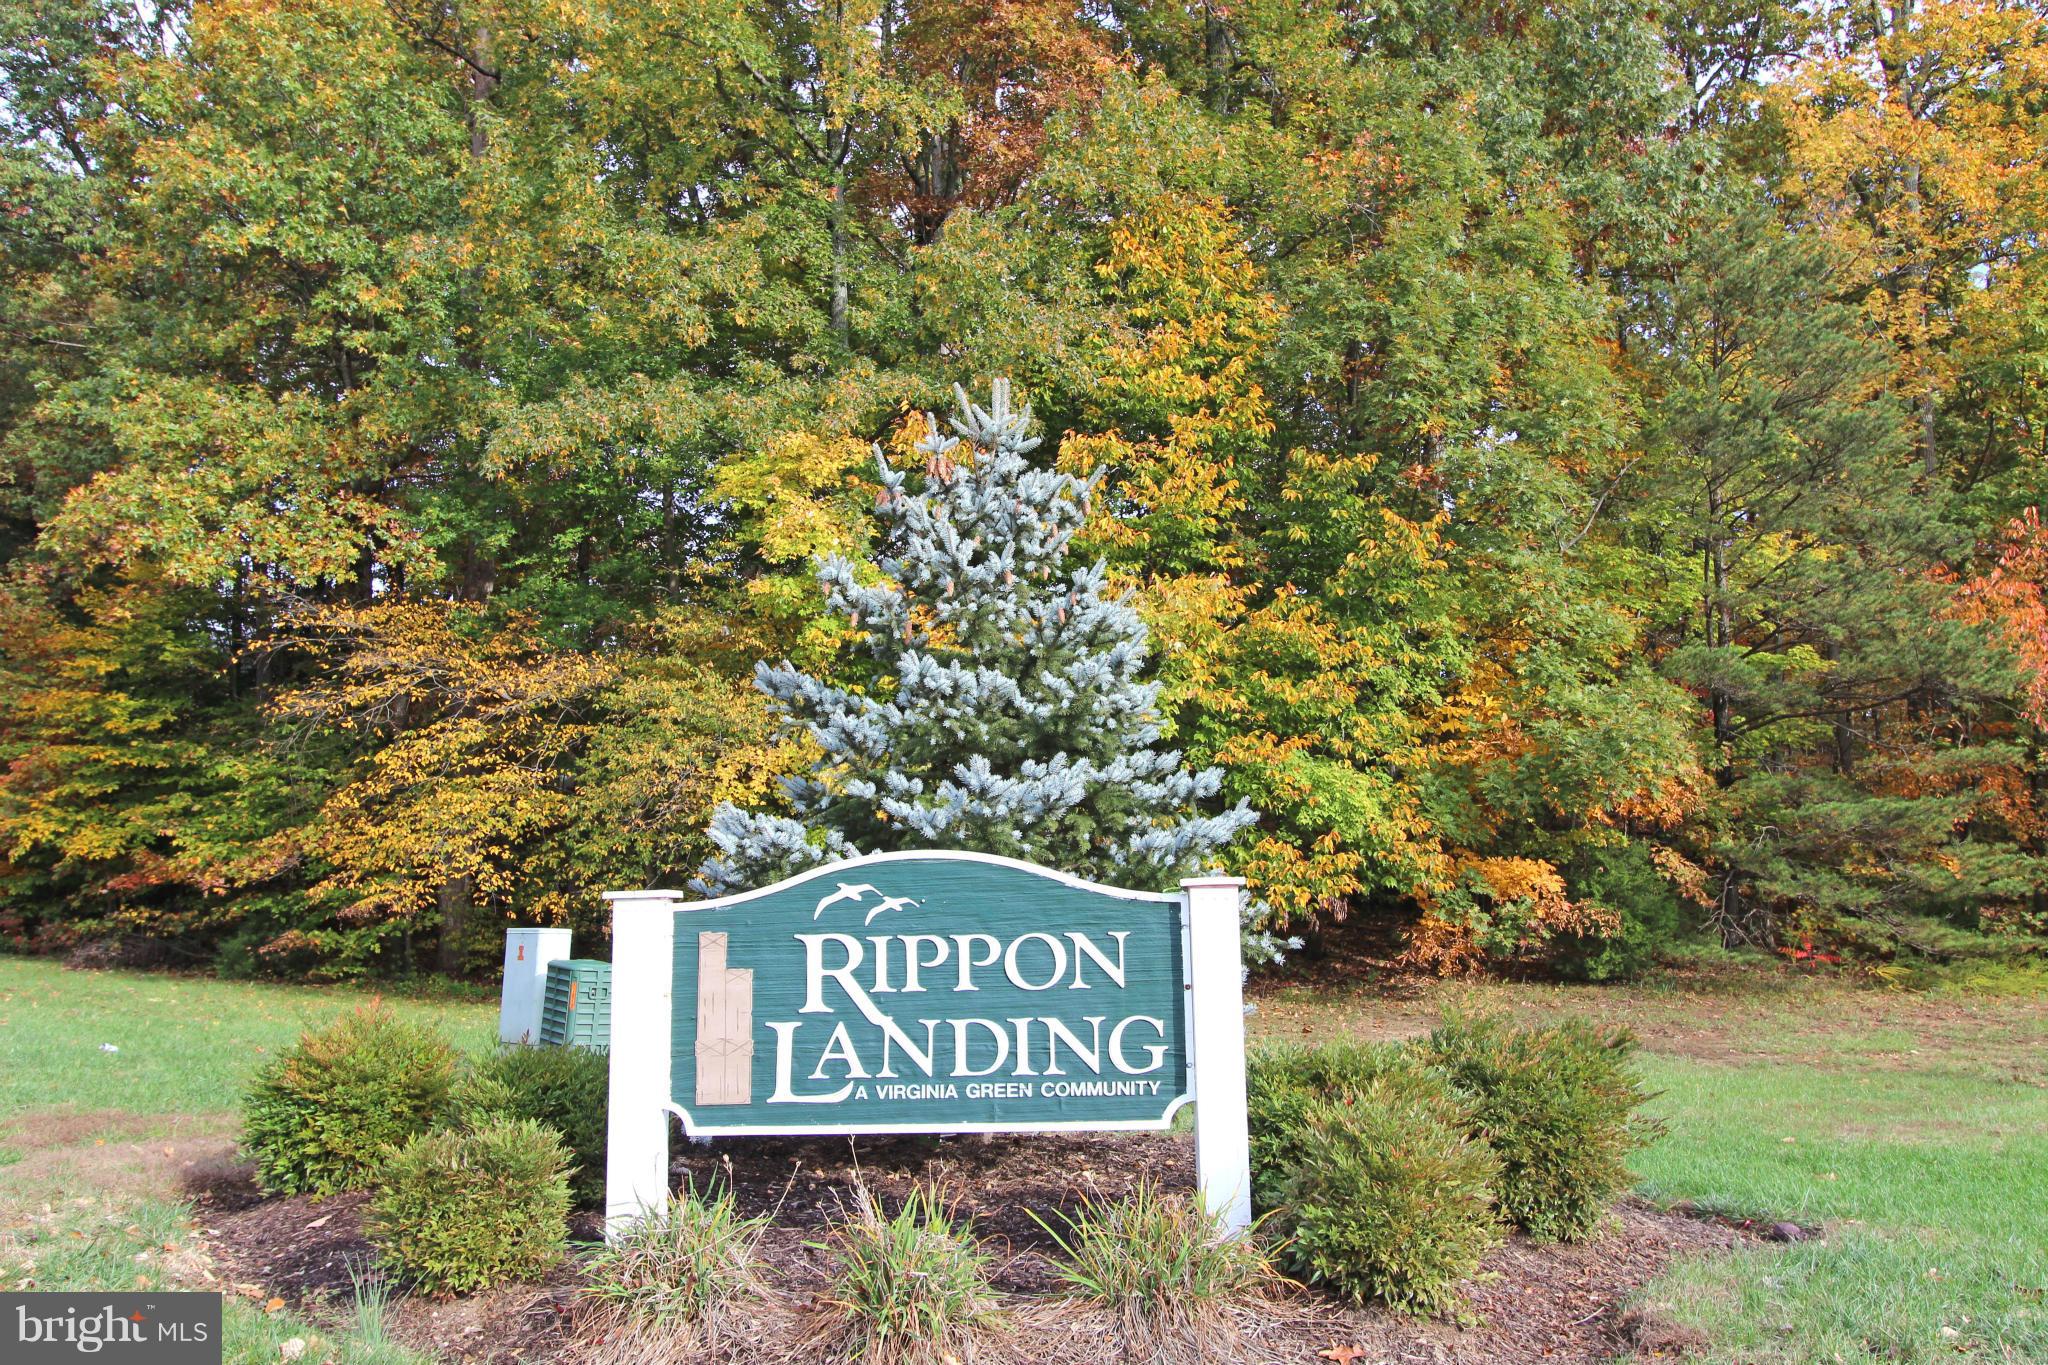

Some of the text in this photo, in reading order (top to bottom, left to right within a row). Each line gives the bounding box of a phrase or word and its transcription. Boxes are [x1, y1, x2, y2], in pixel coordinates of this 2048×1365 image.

[794, 931, 1132, 1026] RIPPON
[765, 1014, 1170, 1104] LANDING
[854, 1080, 1161, 1100] A VIRGINIA GREEN COMMUNITY
